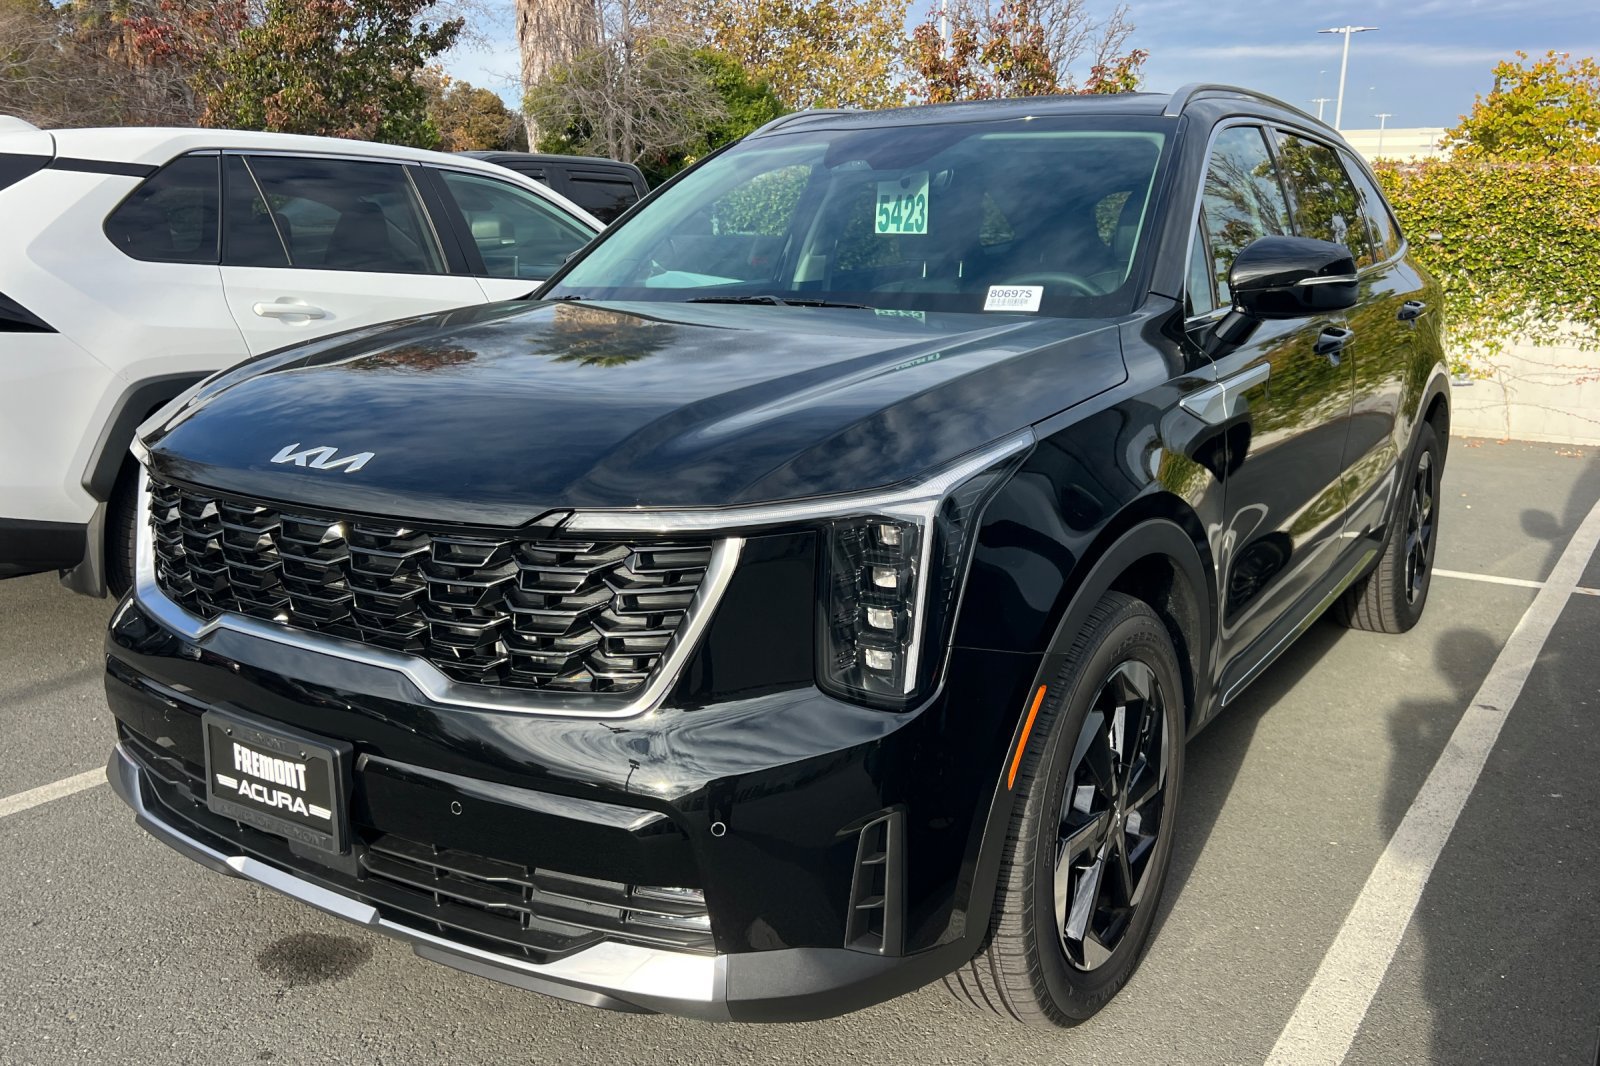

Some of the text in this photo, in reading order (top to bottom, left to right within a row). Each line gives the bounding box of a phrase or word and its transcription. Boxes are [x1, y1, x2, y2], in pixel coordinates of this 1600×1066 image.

[877, 193, 926, 233] 5423
[270, 442, 375, 473] KIA
[233, 742, 306, 792] FREMONT
[238, 779, 309, 817] ACURA
